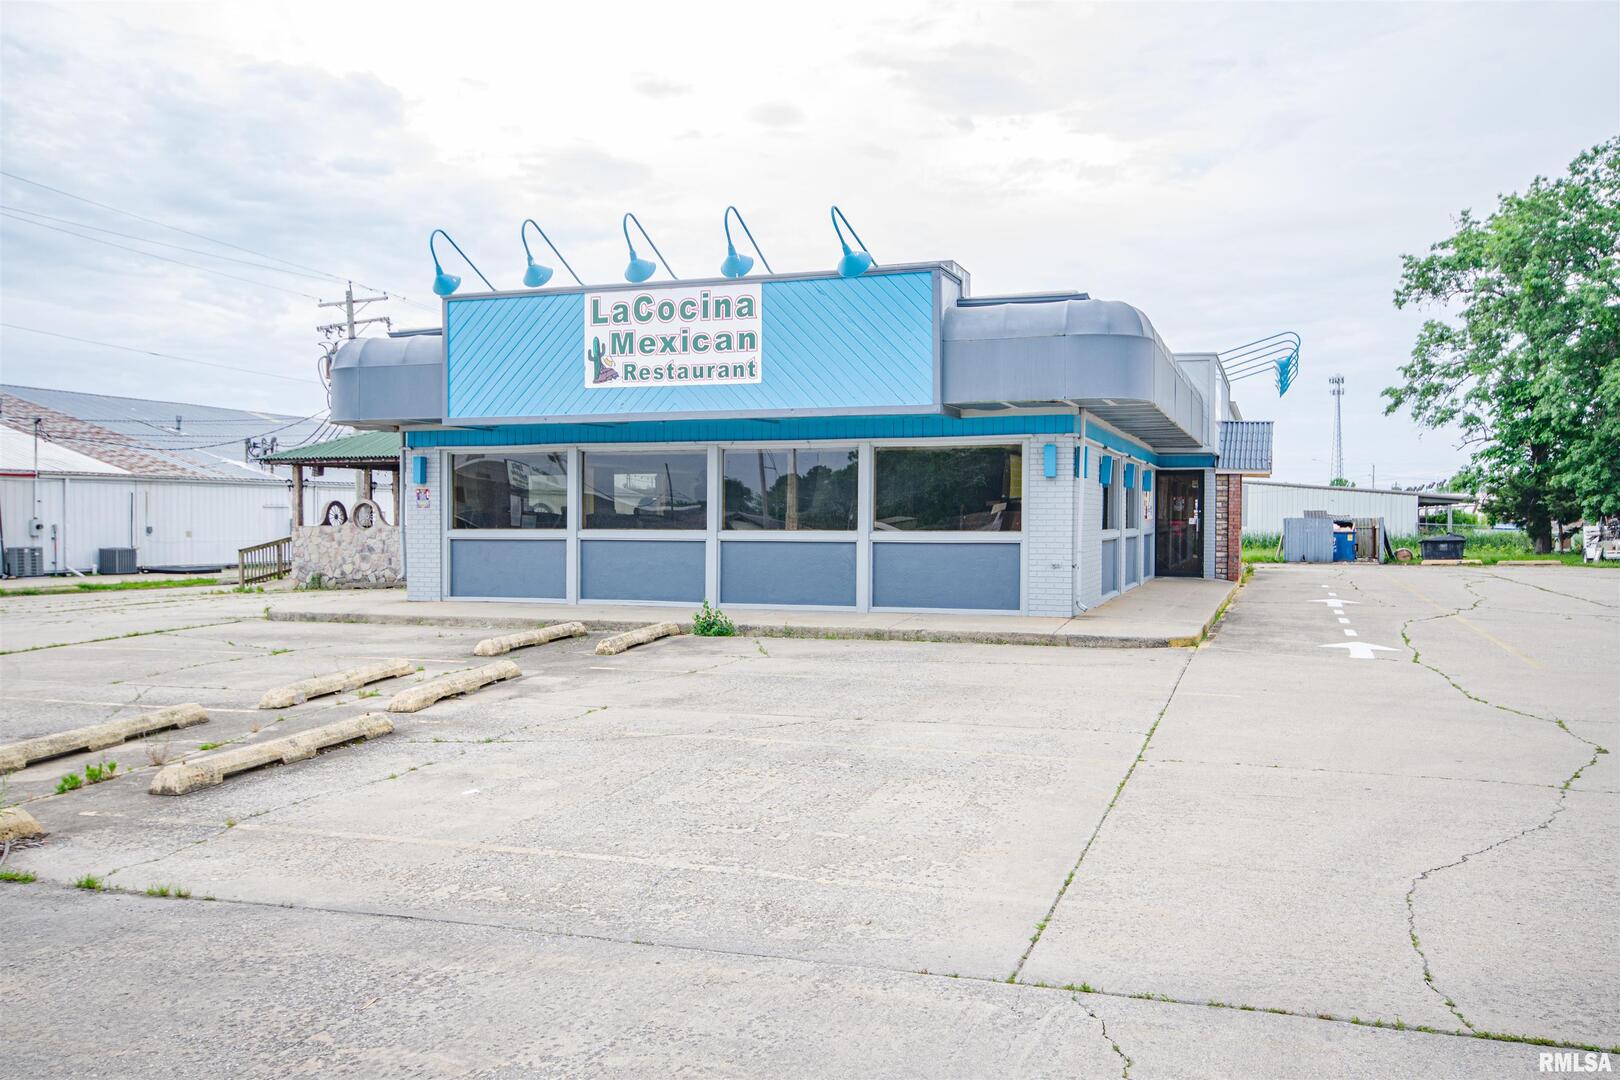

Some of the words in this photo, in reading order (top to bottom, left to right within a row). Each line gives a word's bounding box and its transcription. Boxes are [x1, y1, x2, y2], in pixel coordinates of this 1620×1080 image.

[591, 291, 756, 325] LaCocina
[610, 329, 757, 355] Mexican
[623, 359, 757, 382] Restaurant
